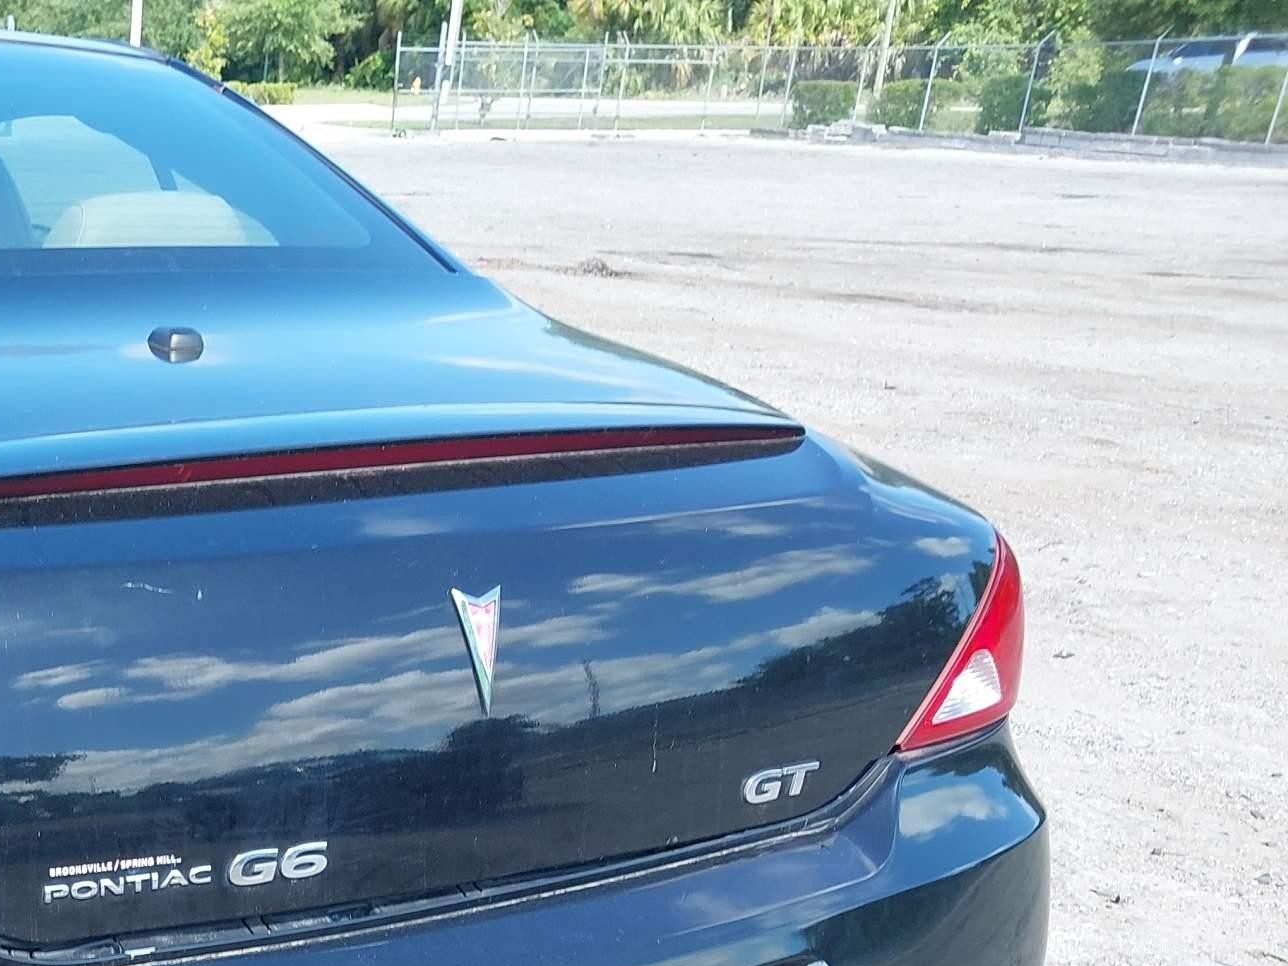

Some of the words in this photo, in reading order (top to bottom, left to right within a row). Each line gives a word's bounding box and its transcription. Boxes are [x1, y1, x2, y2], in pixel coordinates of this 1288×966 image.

[743, 761, 820, 804] GT
[43, 865, 212, 904] PONTIAC
[228, 841, 328, 886] G6
